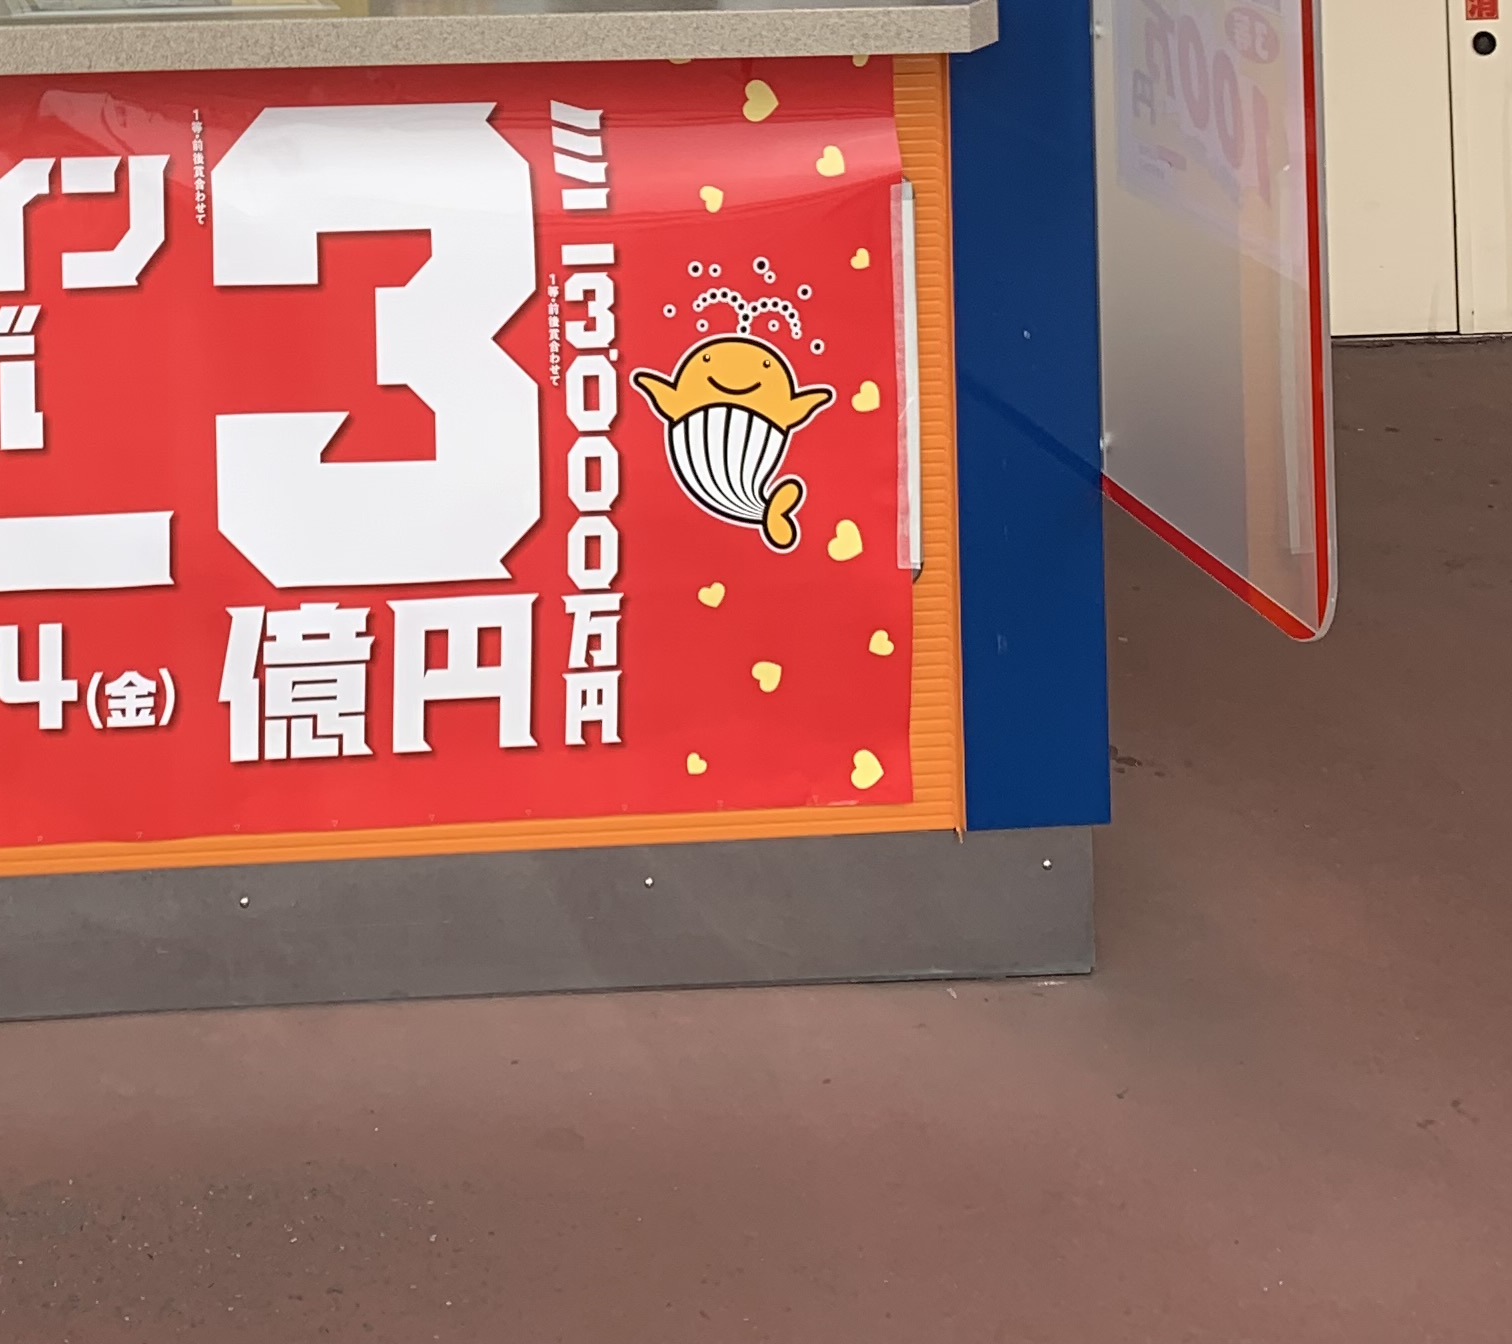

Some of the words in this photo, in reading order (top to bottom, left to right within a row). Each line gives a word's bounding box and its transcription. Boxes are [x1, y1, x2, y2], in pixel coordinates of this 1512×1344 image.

[191, 108, 207, 225] 1等・前後賞合わせて
